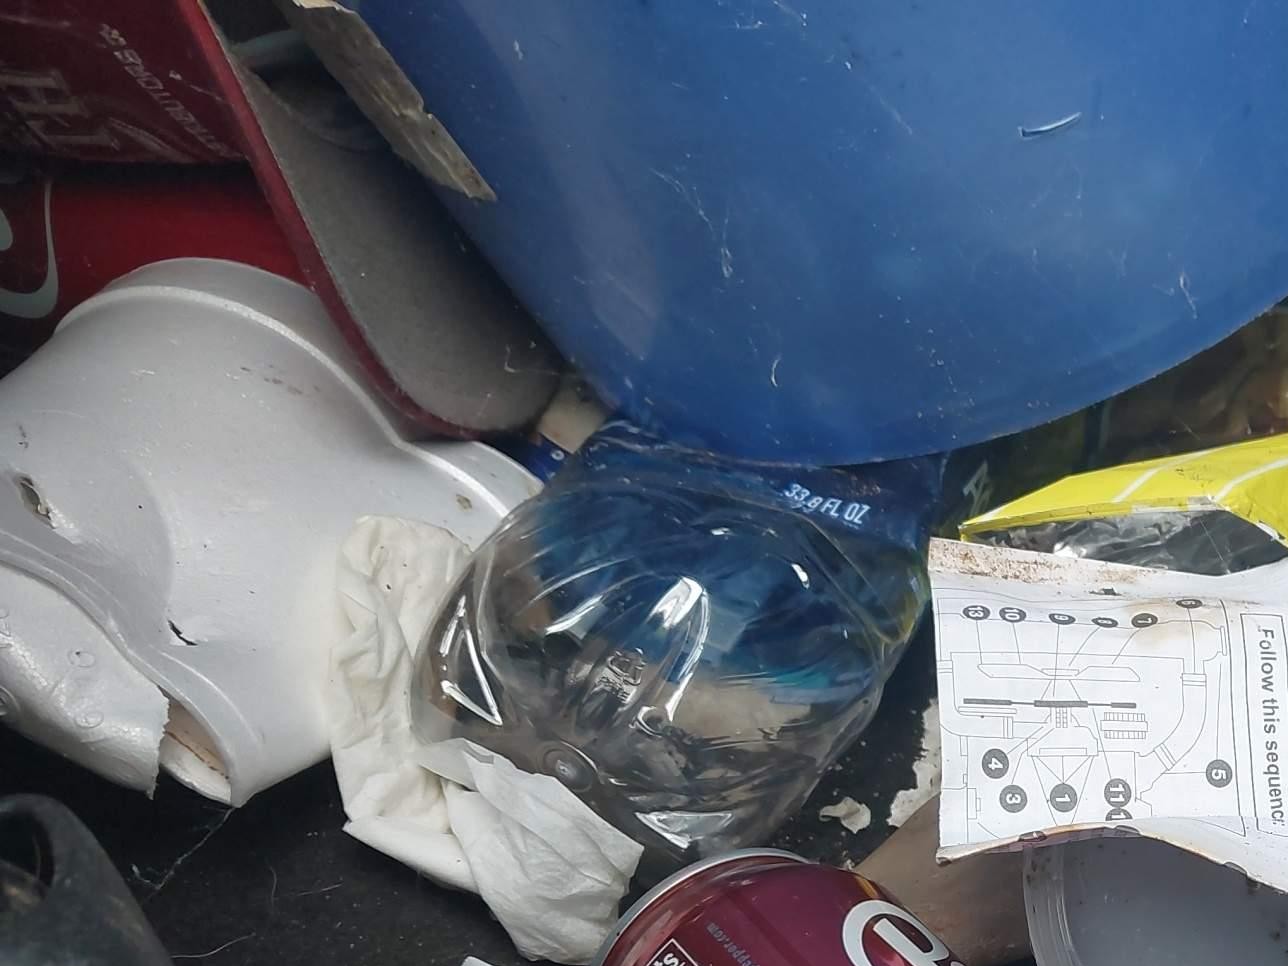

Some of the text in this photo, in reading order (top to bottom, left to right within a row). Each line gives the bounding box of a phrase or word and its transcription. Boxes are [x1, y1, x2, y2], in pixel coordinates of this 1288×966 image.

[783, 483, 871, 524] 33.8 FL OZ
[1258, 628, 1277, 692] Follow
[1262, 697, 1280, 735] this
